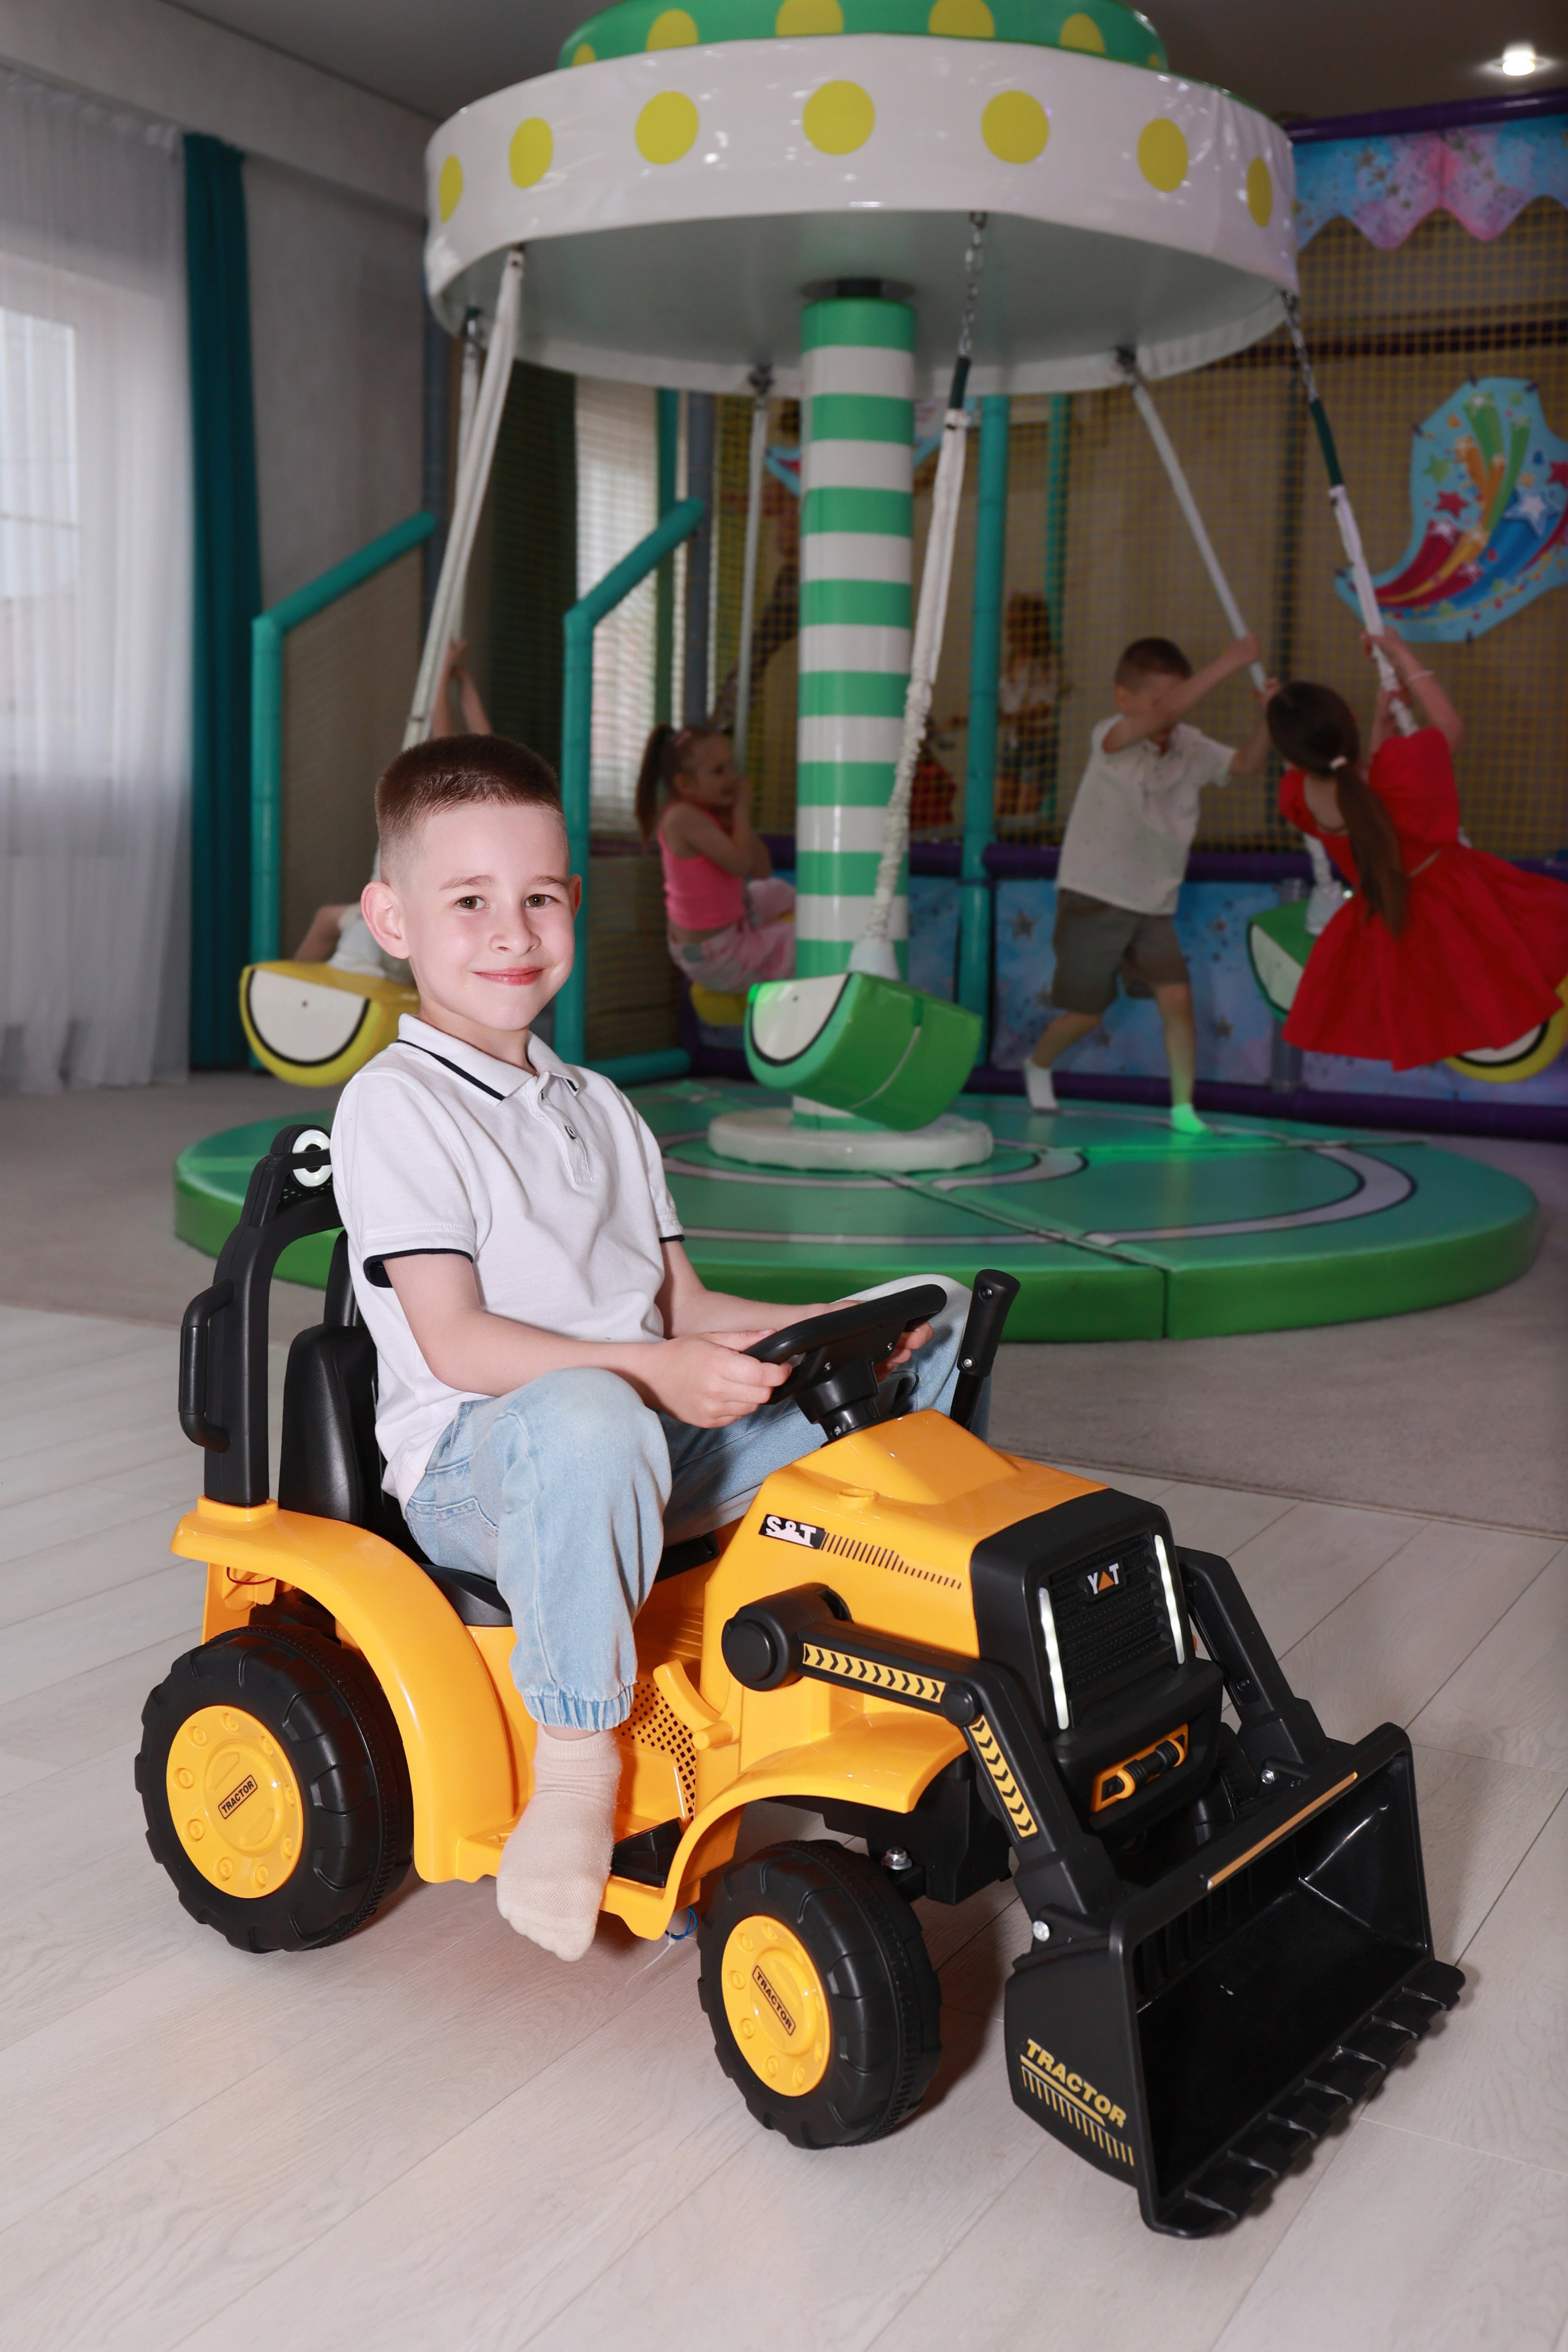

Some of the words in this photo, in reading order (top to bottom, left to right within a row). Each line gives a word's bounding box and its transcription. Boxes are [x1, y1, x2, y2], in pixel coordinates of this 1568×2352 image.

[766, 1516, 816, 1547] S&T
[221, 1780, 254, 1813] TRACTOR
[757, 1972, 792, 2029] TRACTOR
[1027, 2038, 1127, 2128] TRACTOR
